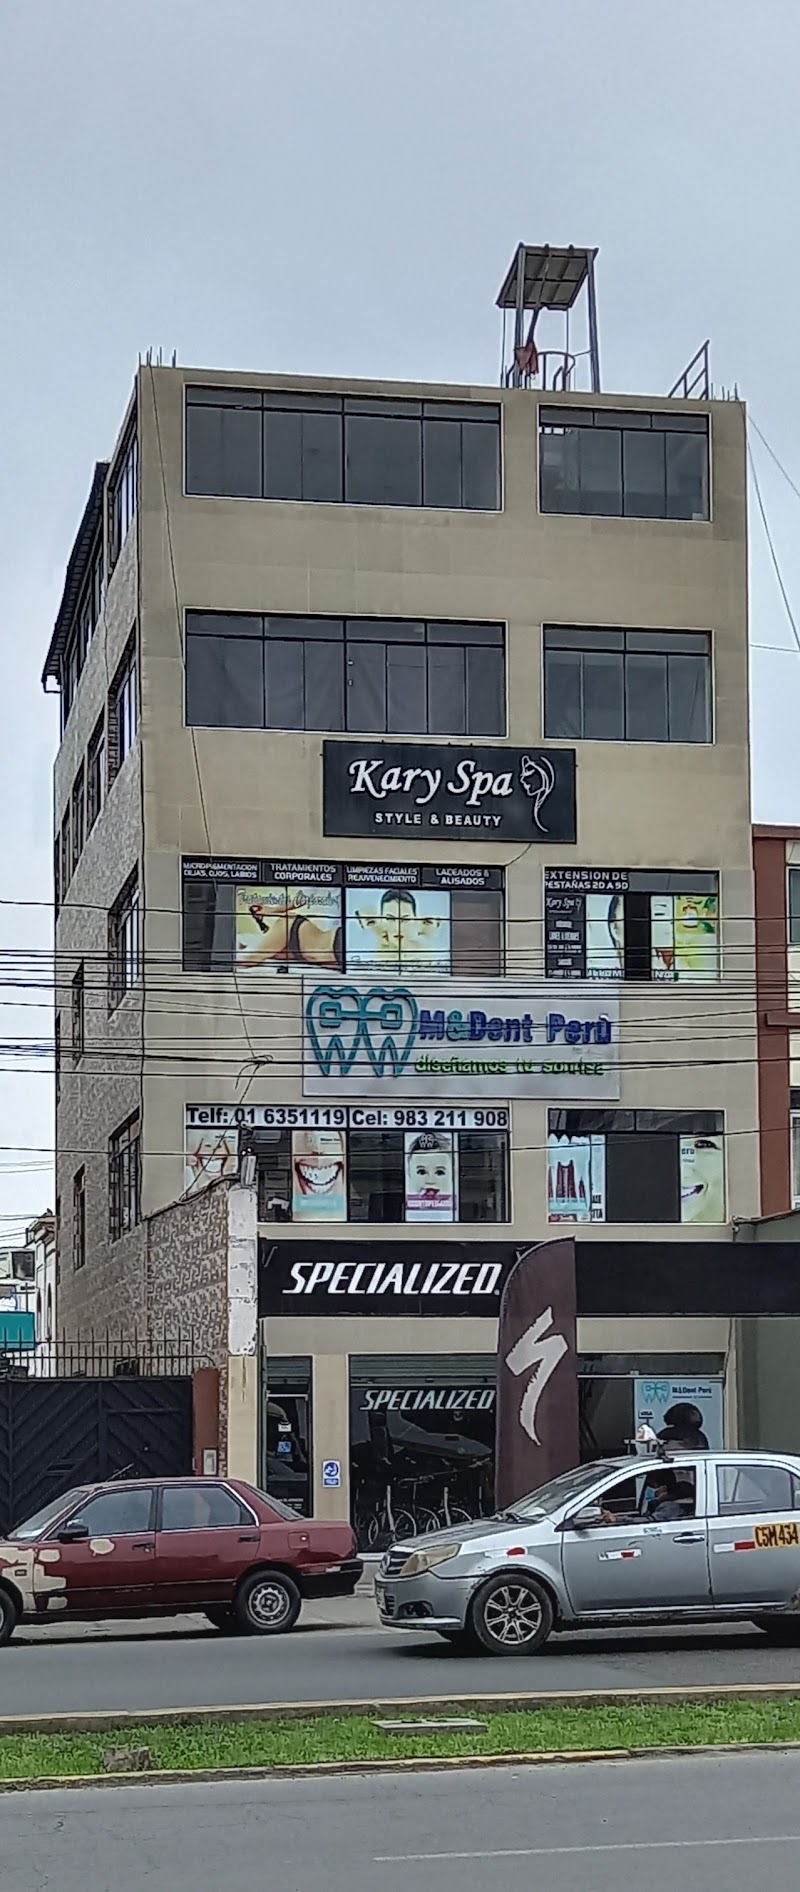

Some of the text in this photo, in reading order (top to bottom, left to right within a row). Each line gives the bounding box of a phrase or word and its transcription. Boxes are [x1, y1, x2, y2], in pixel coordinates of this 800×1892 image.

[349, 759, 513, 806] Kary Spa
[375, 812, 501, 827] STYLE & BEAUTY
[271, 863, 337, 873] TRATAMIENTOS
[436, 868, 483, 877] LACEADOS
[545, 871, 628, 880] EXTENSION DE
[274, 872, 332, 881] CORPORALES
[440, 877, 485, 885] ALISADOS
[187, 1107, 345, 1125] Telf: 01 6351119
[352, 1109, 507, 1127] Cel: 983 211 908
[282, 1262, 502, 1296] SPECIALIZED
[360, 1389, 496, 1412] SPECIALIZED
